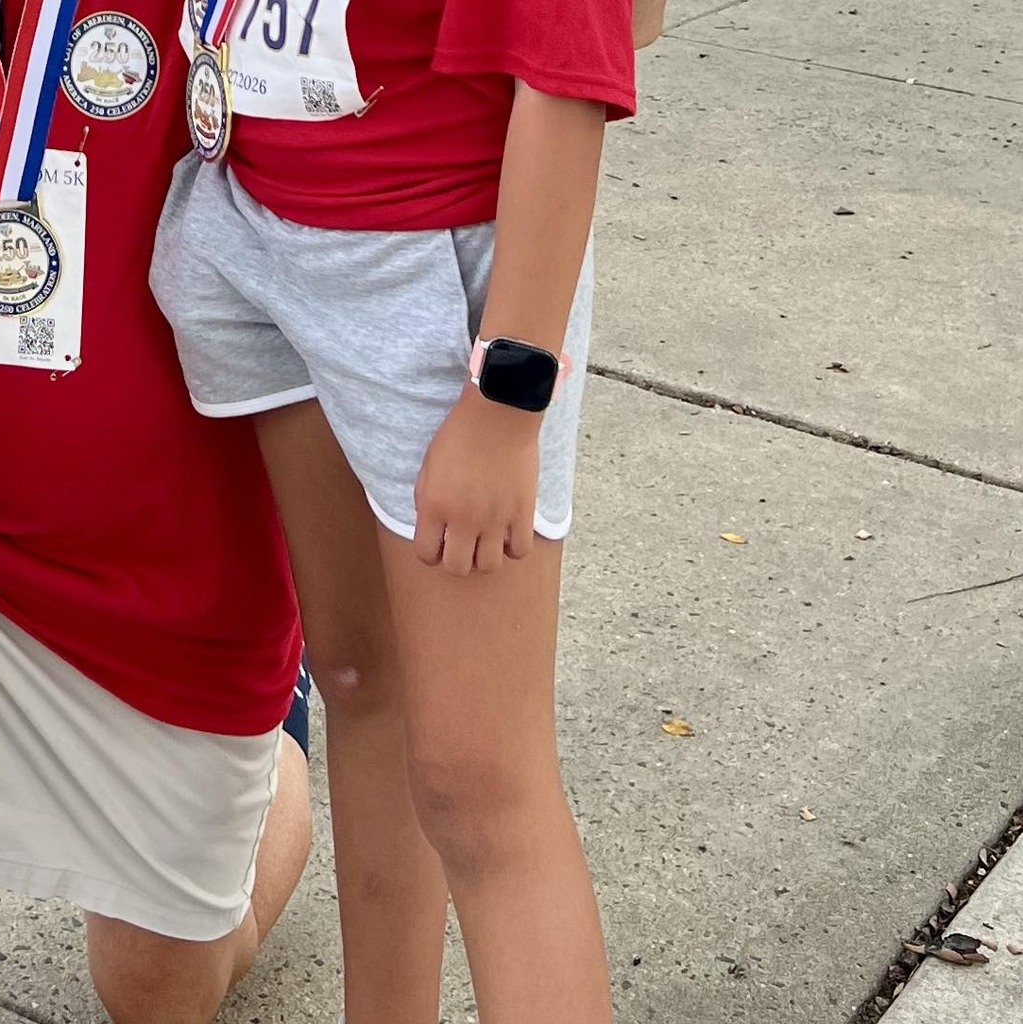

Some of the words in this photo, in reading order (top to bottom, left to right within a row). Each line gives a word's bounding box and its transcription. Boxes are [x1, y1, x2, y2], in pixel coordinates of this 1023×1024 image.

[71, 28, 82, 41] OF
[127, 20, 156, 66] MARYLAND
[89, 41, 130, 64] 250
[63, 74, 88, 110] AMERICA
[89, 105, 105, 116] 250
[106, 79, 154, 116] CELEBRATION
[63, 170, 85, 187] 5K
[21, 214, 56, 257] MARYLAND
[0, 304, 14, 314] 250
[16, 270, 57, 313] CELEBRATION
